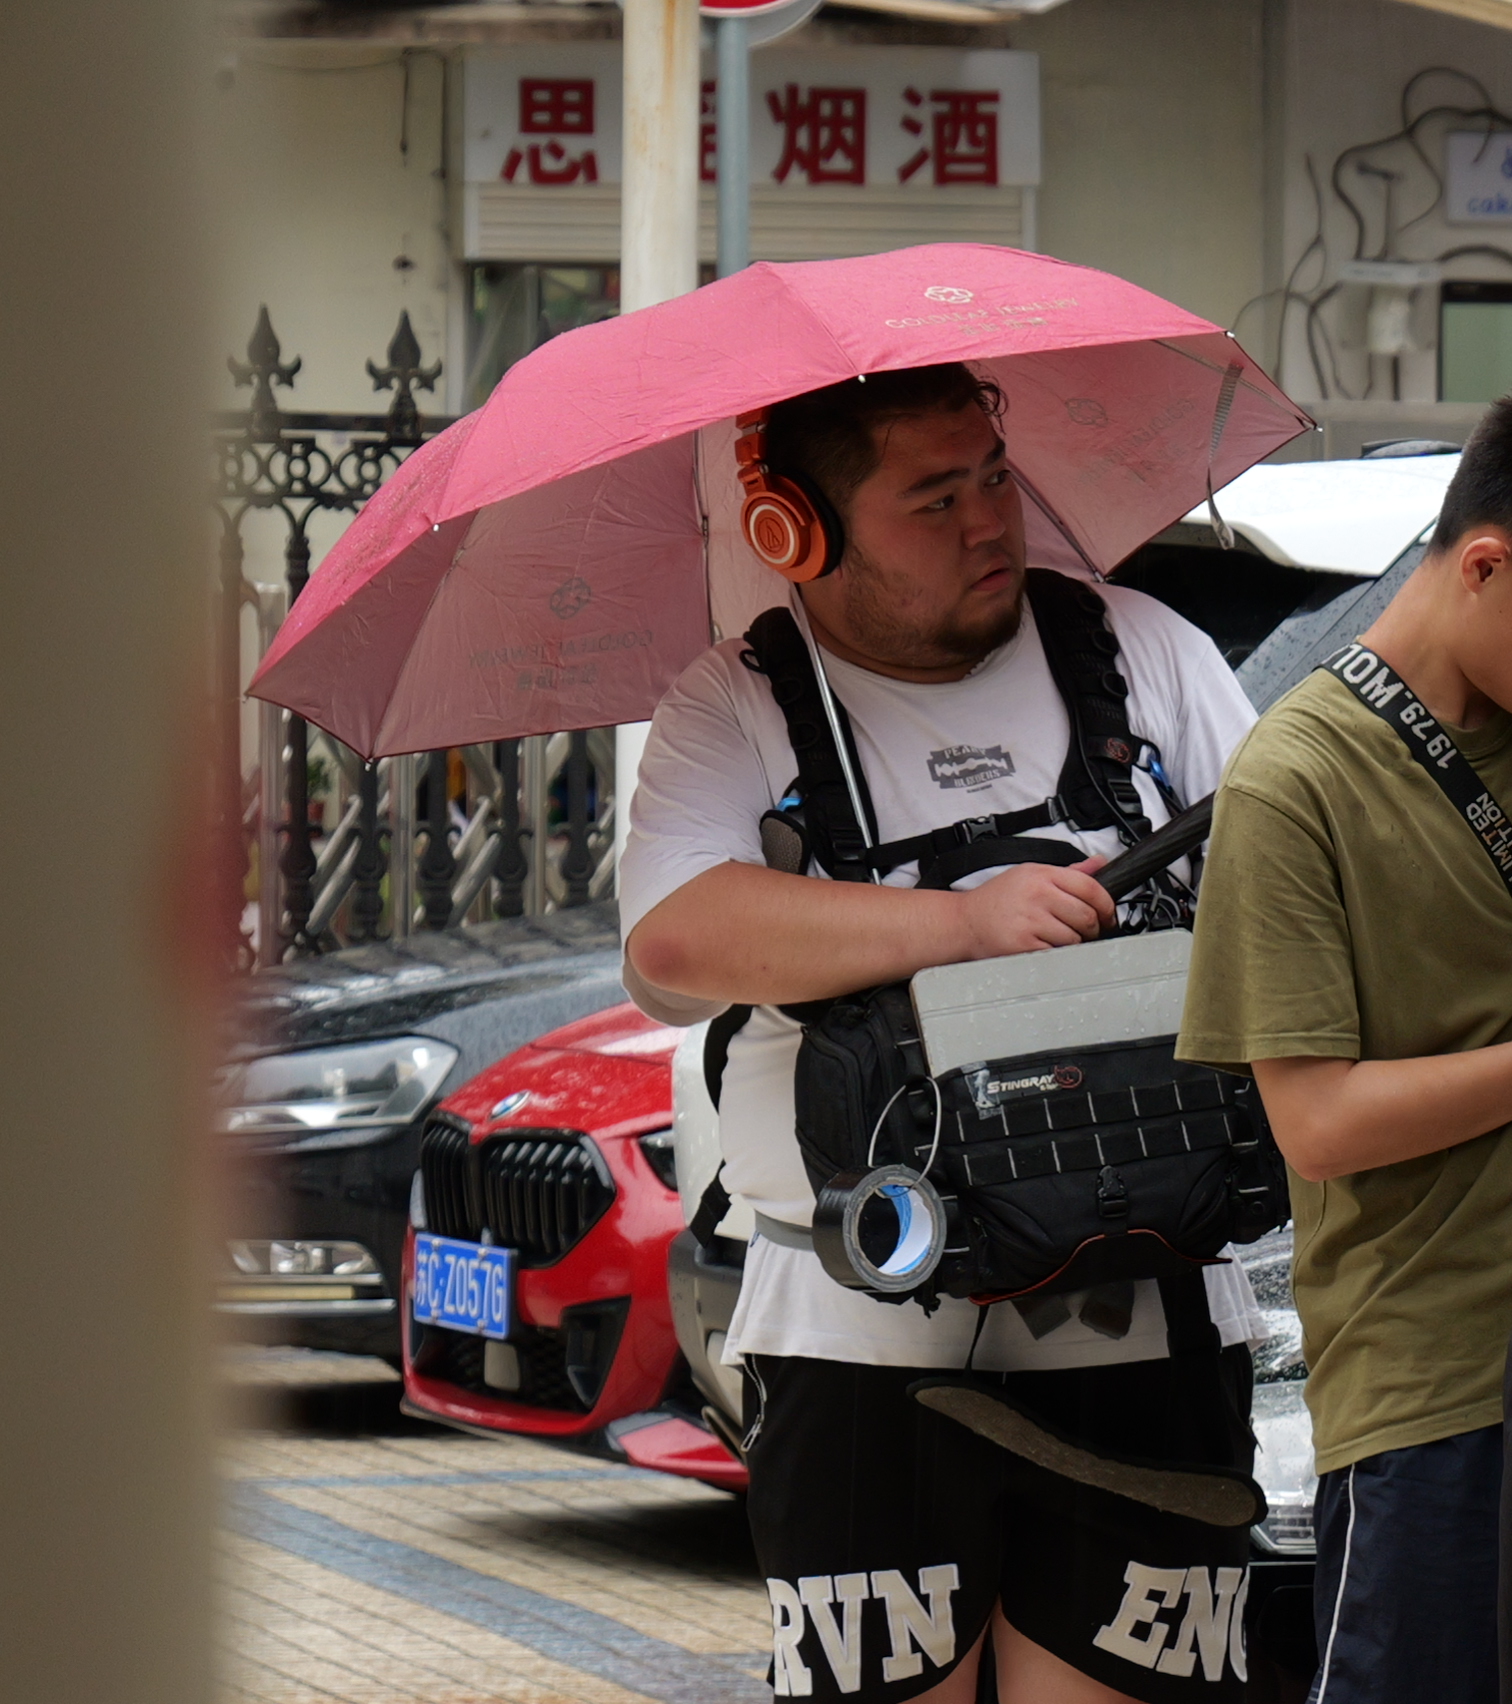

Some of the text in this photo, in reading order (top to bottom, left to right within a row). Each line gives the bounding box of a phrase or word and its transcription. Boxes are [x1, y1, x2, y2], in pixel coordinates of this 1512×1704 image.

[502, 78, 1002, 187] 思烟酒
[1321, 643, 1405, 709] WOL
[986, 1073, 1055, 1095] STINGRAY
